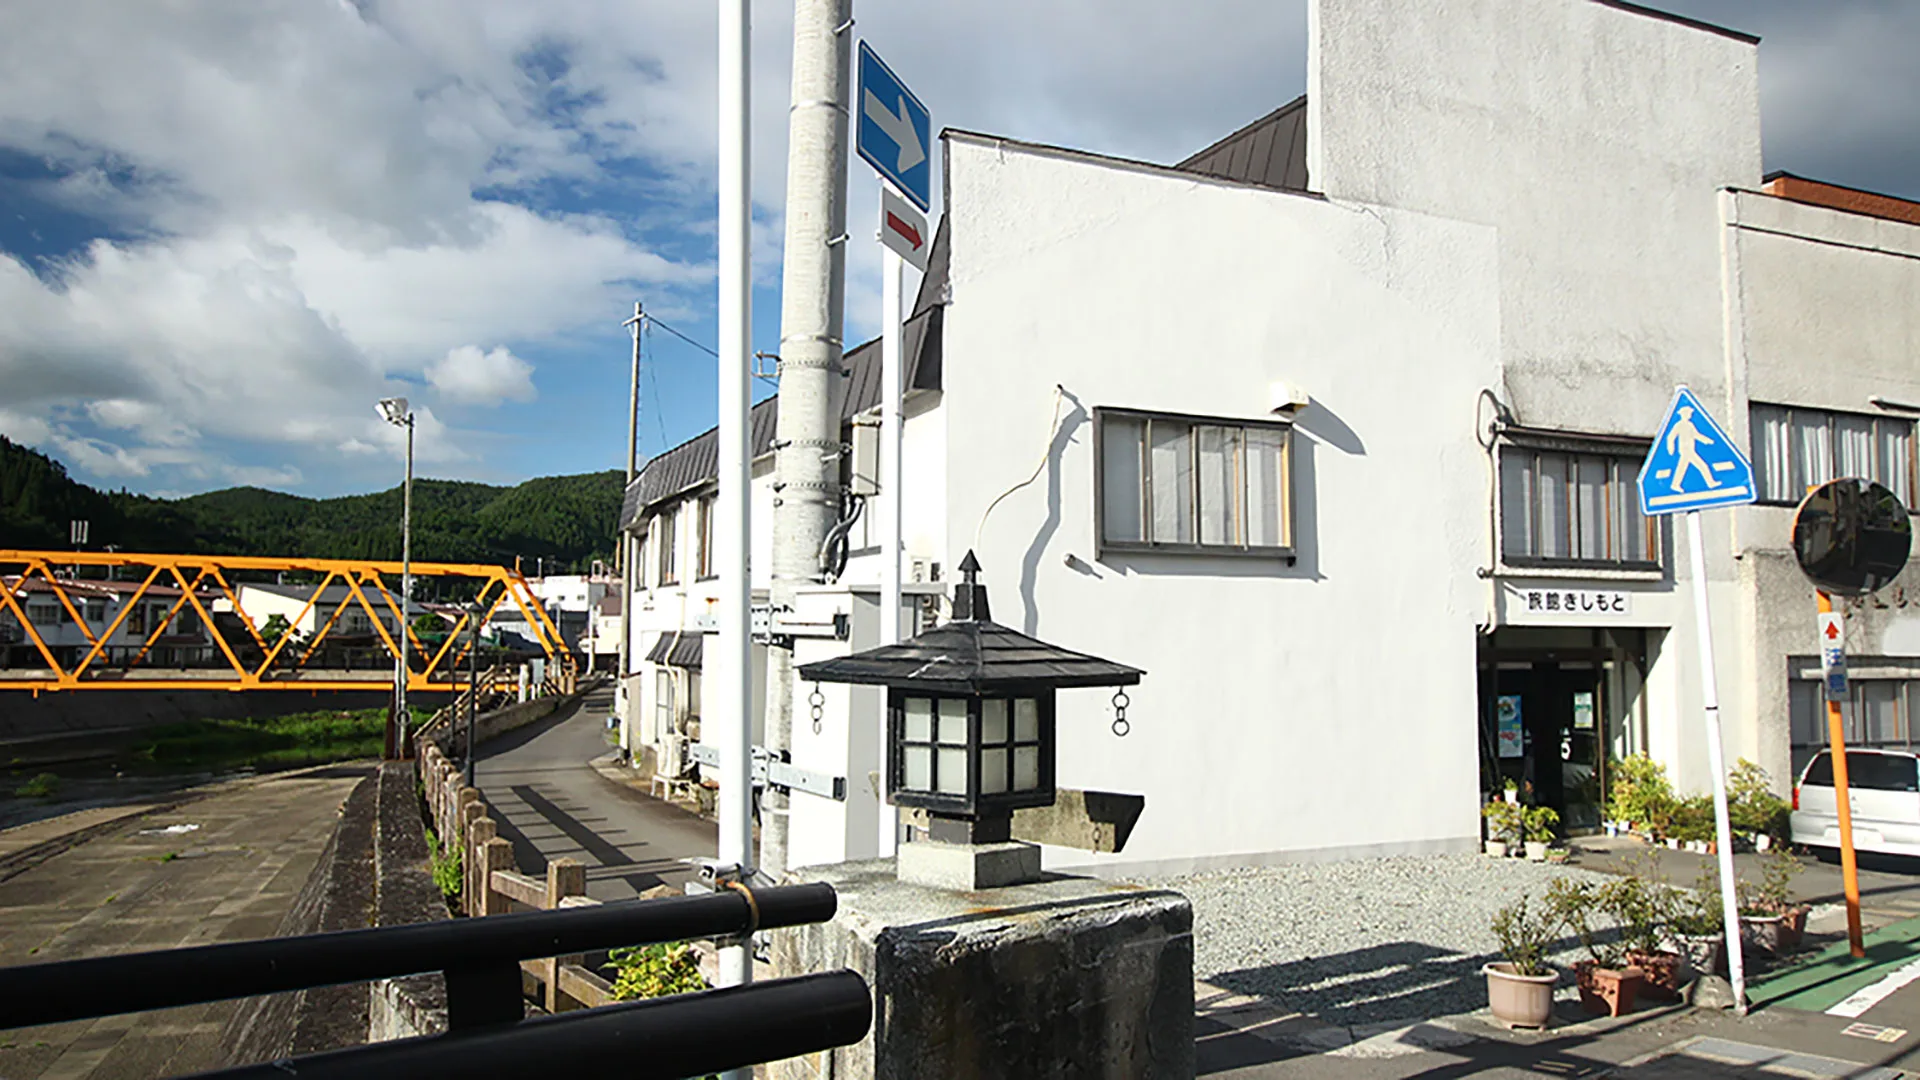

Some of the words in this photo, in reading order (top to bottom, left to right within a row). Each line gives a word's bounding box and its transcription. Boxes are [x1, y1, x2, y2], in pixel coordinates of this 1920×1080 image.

[1528, 592, 1624, 611] 旅館きしもと
